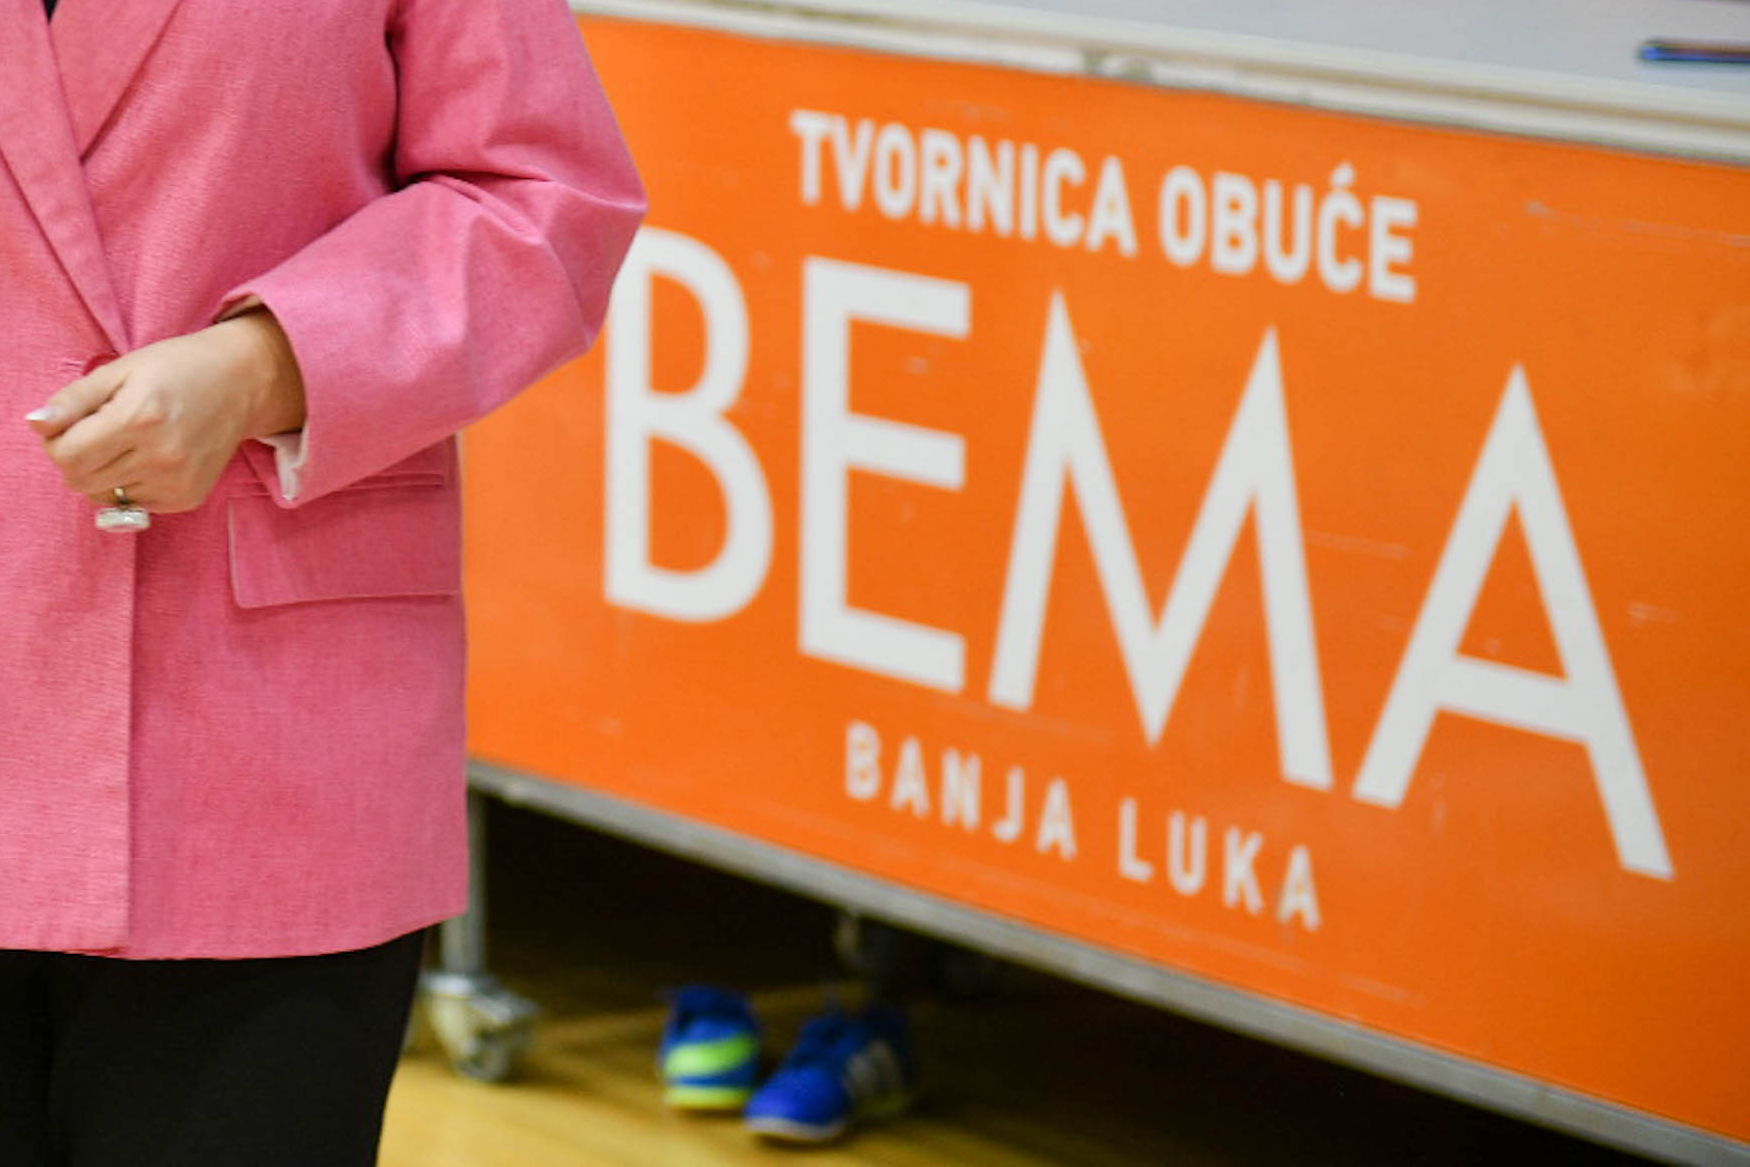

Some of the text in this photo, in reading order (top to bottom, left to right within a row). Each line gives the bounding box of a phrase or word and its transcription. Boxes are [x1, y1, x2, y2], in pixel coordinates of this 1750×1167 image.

[789, 109, 1419, 303] TVORNICA OBUĆE
[603, 224, 1673, 880] BEMA
[846, 722, 1320, 929] BANJA LUKA
